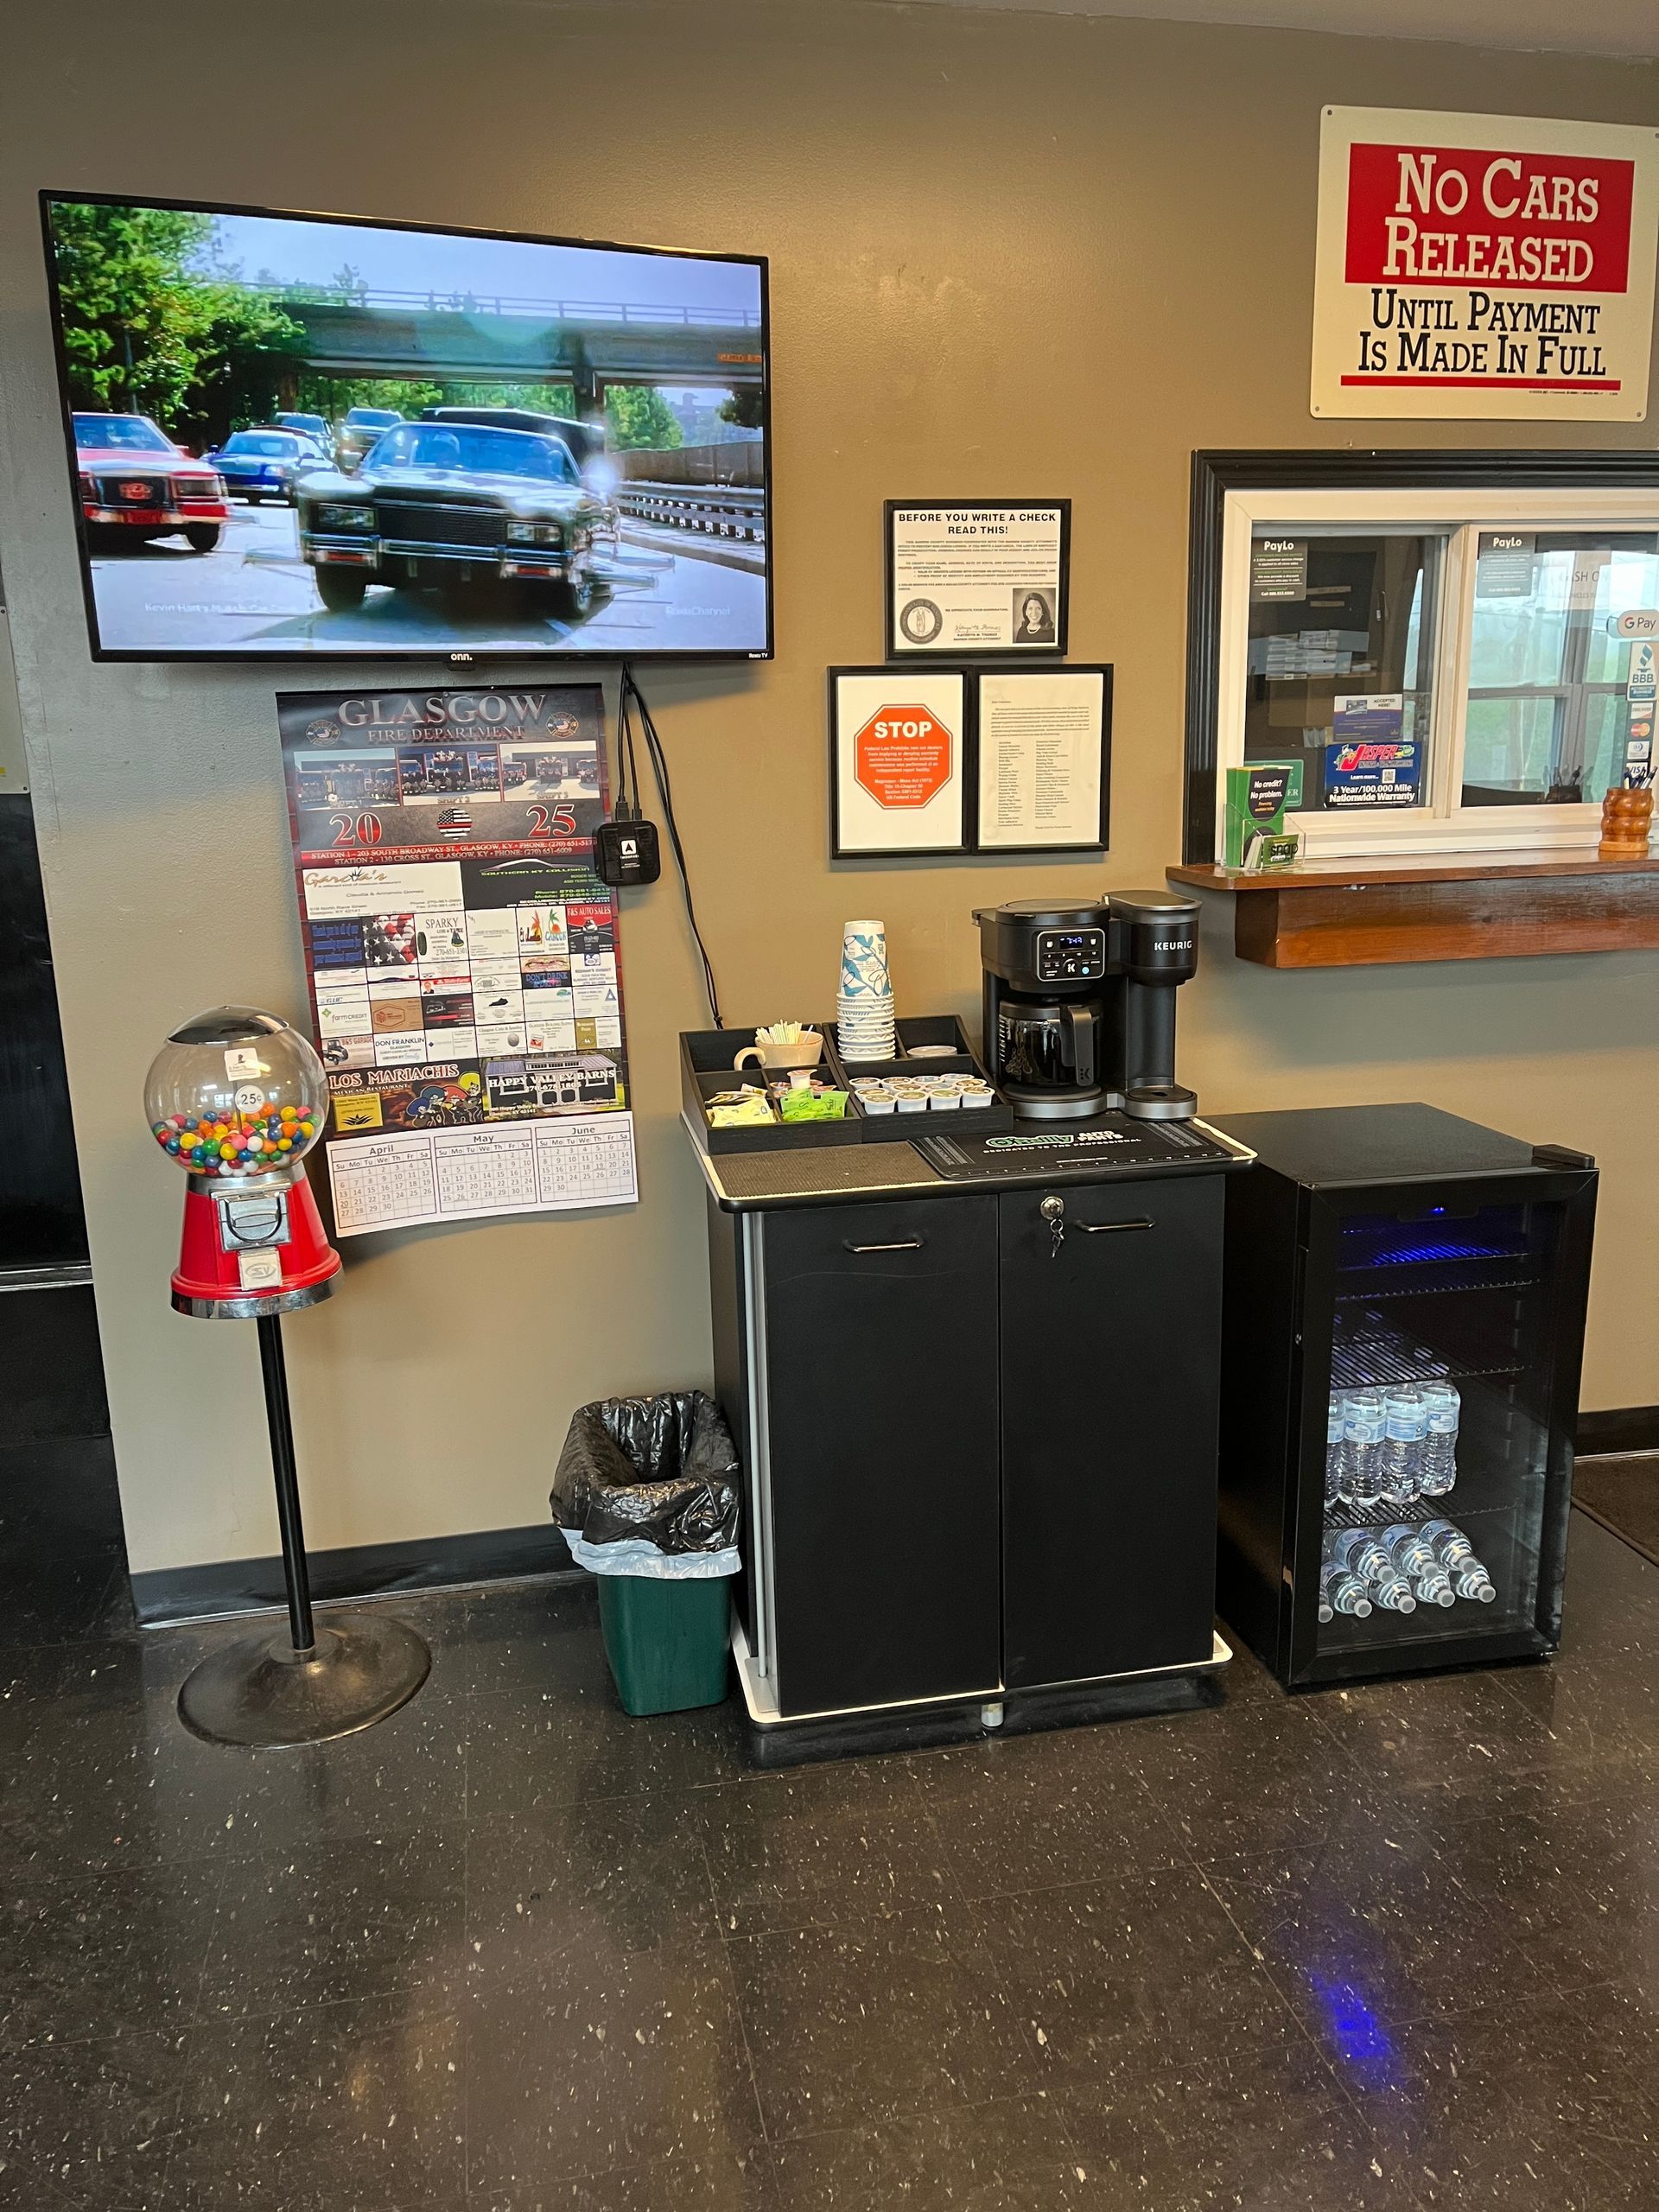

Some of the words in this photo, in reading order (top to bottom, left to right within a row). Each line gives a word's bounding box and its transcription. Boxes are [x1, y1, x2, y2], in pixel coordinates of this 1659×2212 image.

[1395, 153, 1468, 216] NO
[1482, 157, 1599, 223] CARS
[1382, 216, 1594, 283] RELEASED
[1371, 289, 1458, 330] UNTIL
[1467, 291, 1600, 334] PAYMENT
[1358, 331, 1387, 372] IS
[1397, 332, 1488, 373] MADE
[1496, 334, 1529, 374] IN
[1536, 336, 1606, 376] FULL
[899, 513, 942, 522] BEFORE
[945, 513, 969, 522] YOU
[971, 513, 1006, 522] WRITE
[1009, 513, 1016, 522] A
[1019, 513, 1056, 522] CHECK
[948, 525, 977, 534] READ
[980, 525, 1008, 534] THIS!
[1264, 540, 1294, 552] PayLo
[1493, 537, 1522, 549] PayLo
[1637, 616, 1656, 631] Pay
[450, 652, 474, 662] onn.
[1632, 674, 1654, 683] BBB
[338, 694, 546, 728] GLASGOW
[368, 728, 406, 742] FIRE
[410, 725, 525, 741] DEPARTMENT
[874, 721, 932, 739] STOP
[1340, 744, 1399, 772] JASPER
[1262, 779, 1283, 788] credit?
[1340, 784, 1393, 794] Year/100,000
[1259, 790, 1283, 800] problem.
[1330, 794, 1376, 803] Nationwide
[1376, 792, 1415, 802] Warranty
[329, 812, 382, 846] 20
[526, 804, 576, 837] 25
[461, 842, 501, 851] GLASGOW,
[594, 906, 612, 914] SALES
[426, 918, 459, 929] SPARKY
[1154, 940, 1192, 951] KEURIG
[525, 973, 546, 982] DON'T
[546, 971, 569, 980] DRINK
[329, 1072, 362, 1090] LOS
[367, 1064, 460, 1085] MARIACHIS
[489, 1076, 528, 1088] HAPPY
[528, 1072, 574, 1084] VALLEY
[576, 1069, 615, 1080] BARNS
[366, 1084, 408, 1092] RESTAURANT
[572, 1127, 595, 1135] June
[474, 1135, 494, 1143] May
[985, 1135, 1074, 1147] O'Reilly
[1073, 1138, 1142, 1147] PROFESSIONAL
[369, 1144, 394, 1156] April
